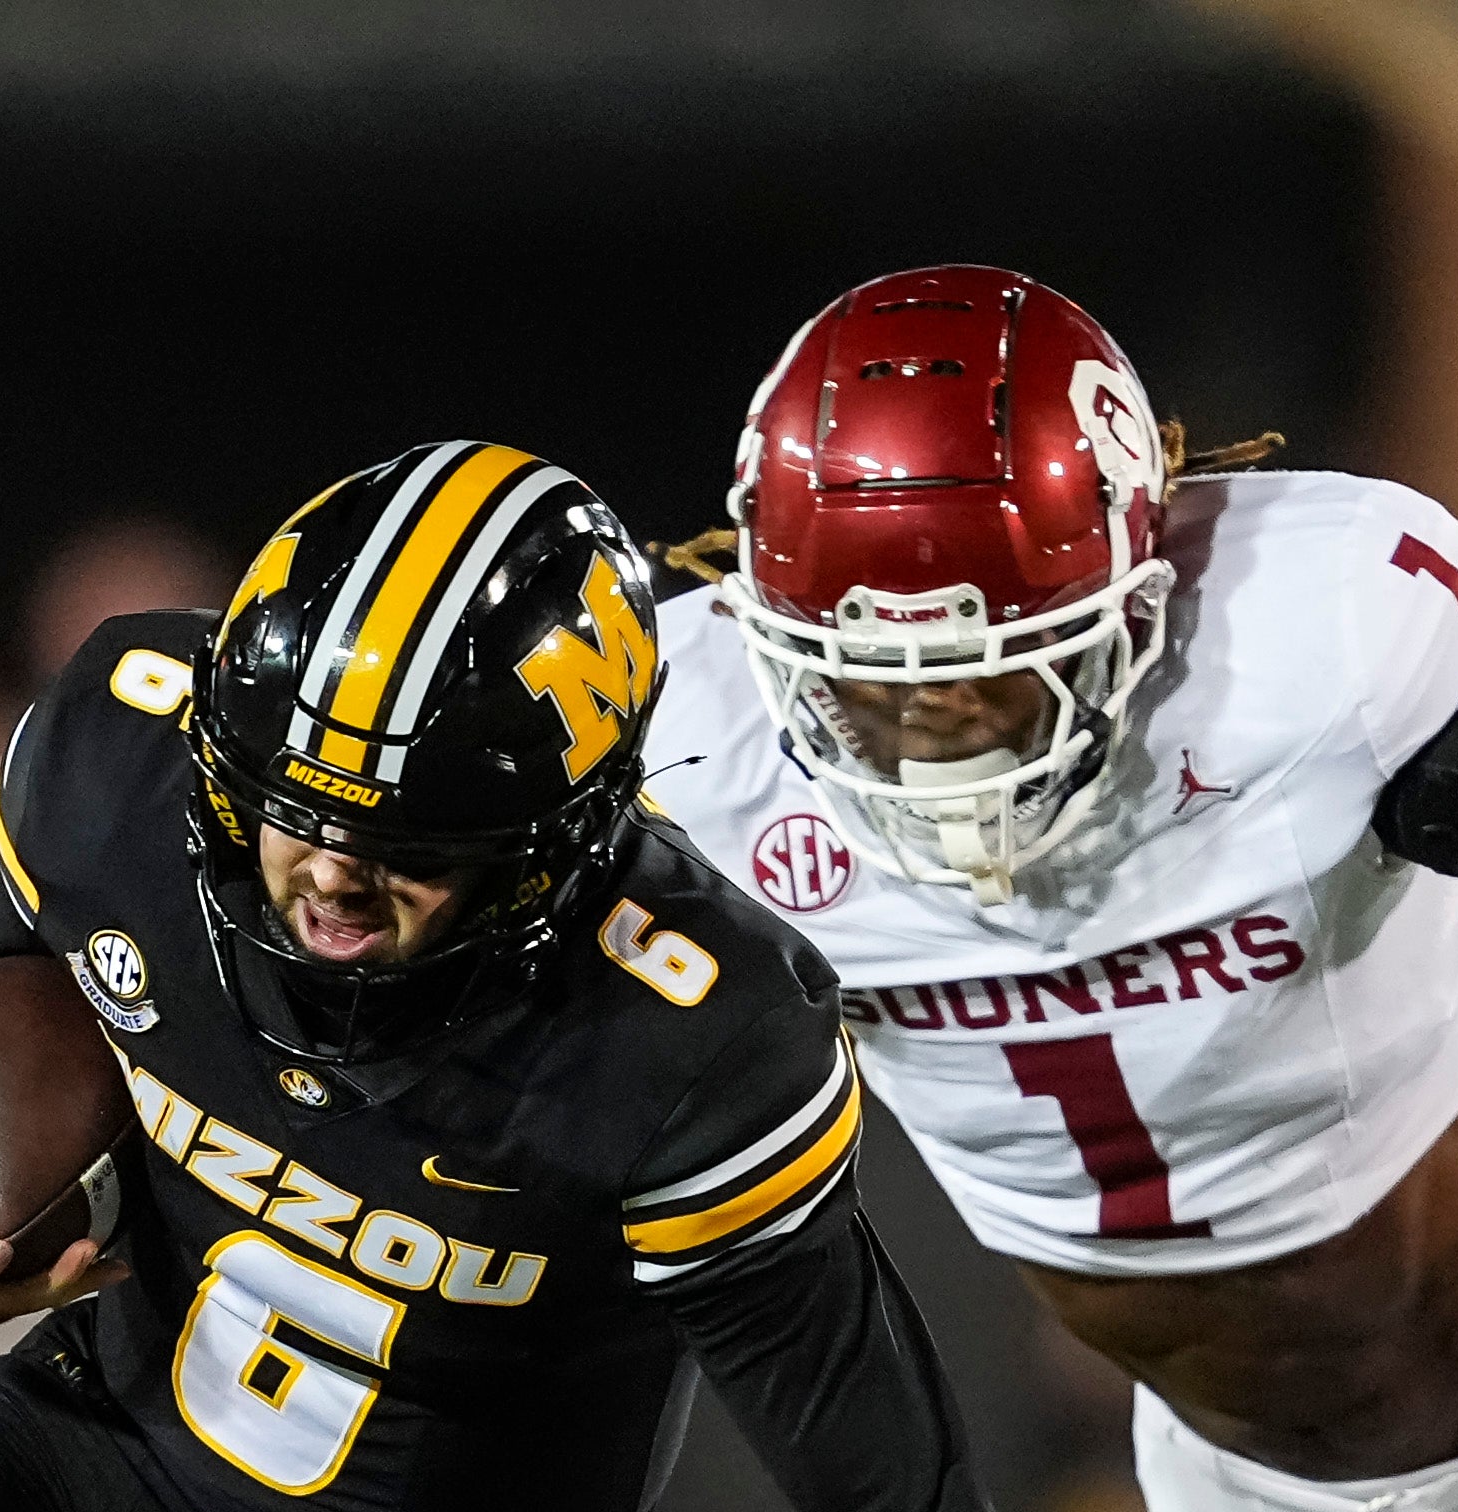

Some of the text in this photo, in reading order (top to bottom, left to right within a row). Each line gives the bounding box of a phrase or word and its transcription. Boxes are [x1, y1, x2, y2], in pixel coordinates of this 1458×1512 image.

[515, 551, 659, 786] M
[285, 760, 382, 807] MIZZOU
[754, 816, 849, 909] SEC
[79, 973, 143, 1029] GRADUATE
[92, 935, 141, 995] SEC
[598, 898, 719, 1007] 6
[1000, 1032, 1212, 1240] 1
[171, 1230, 408, 1497] 6
